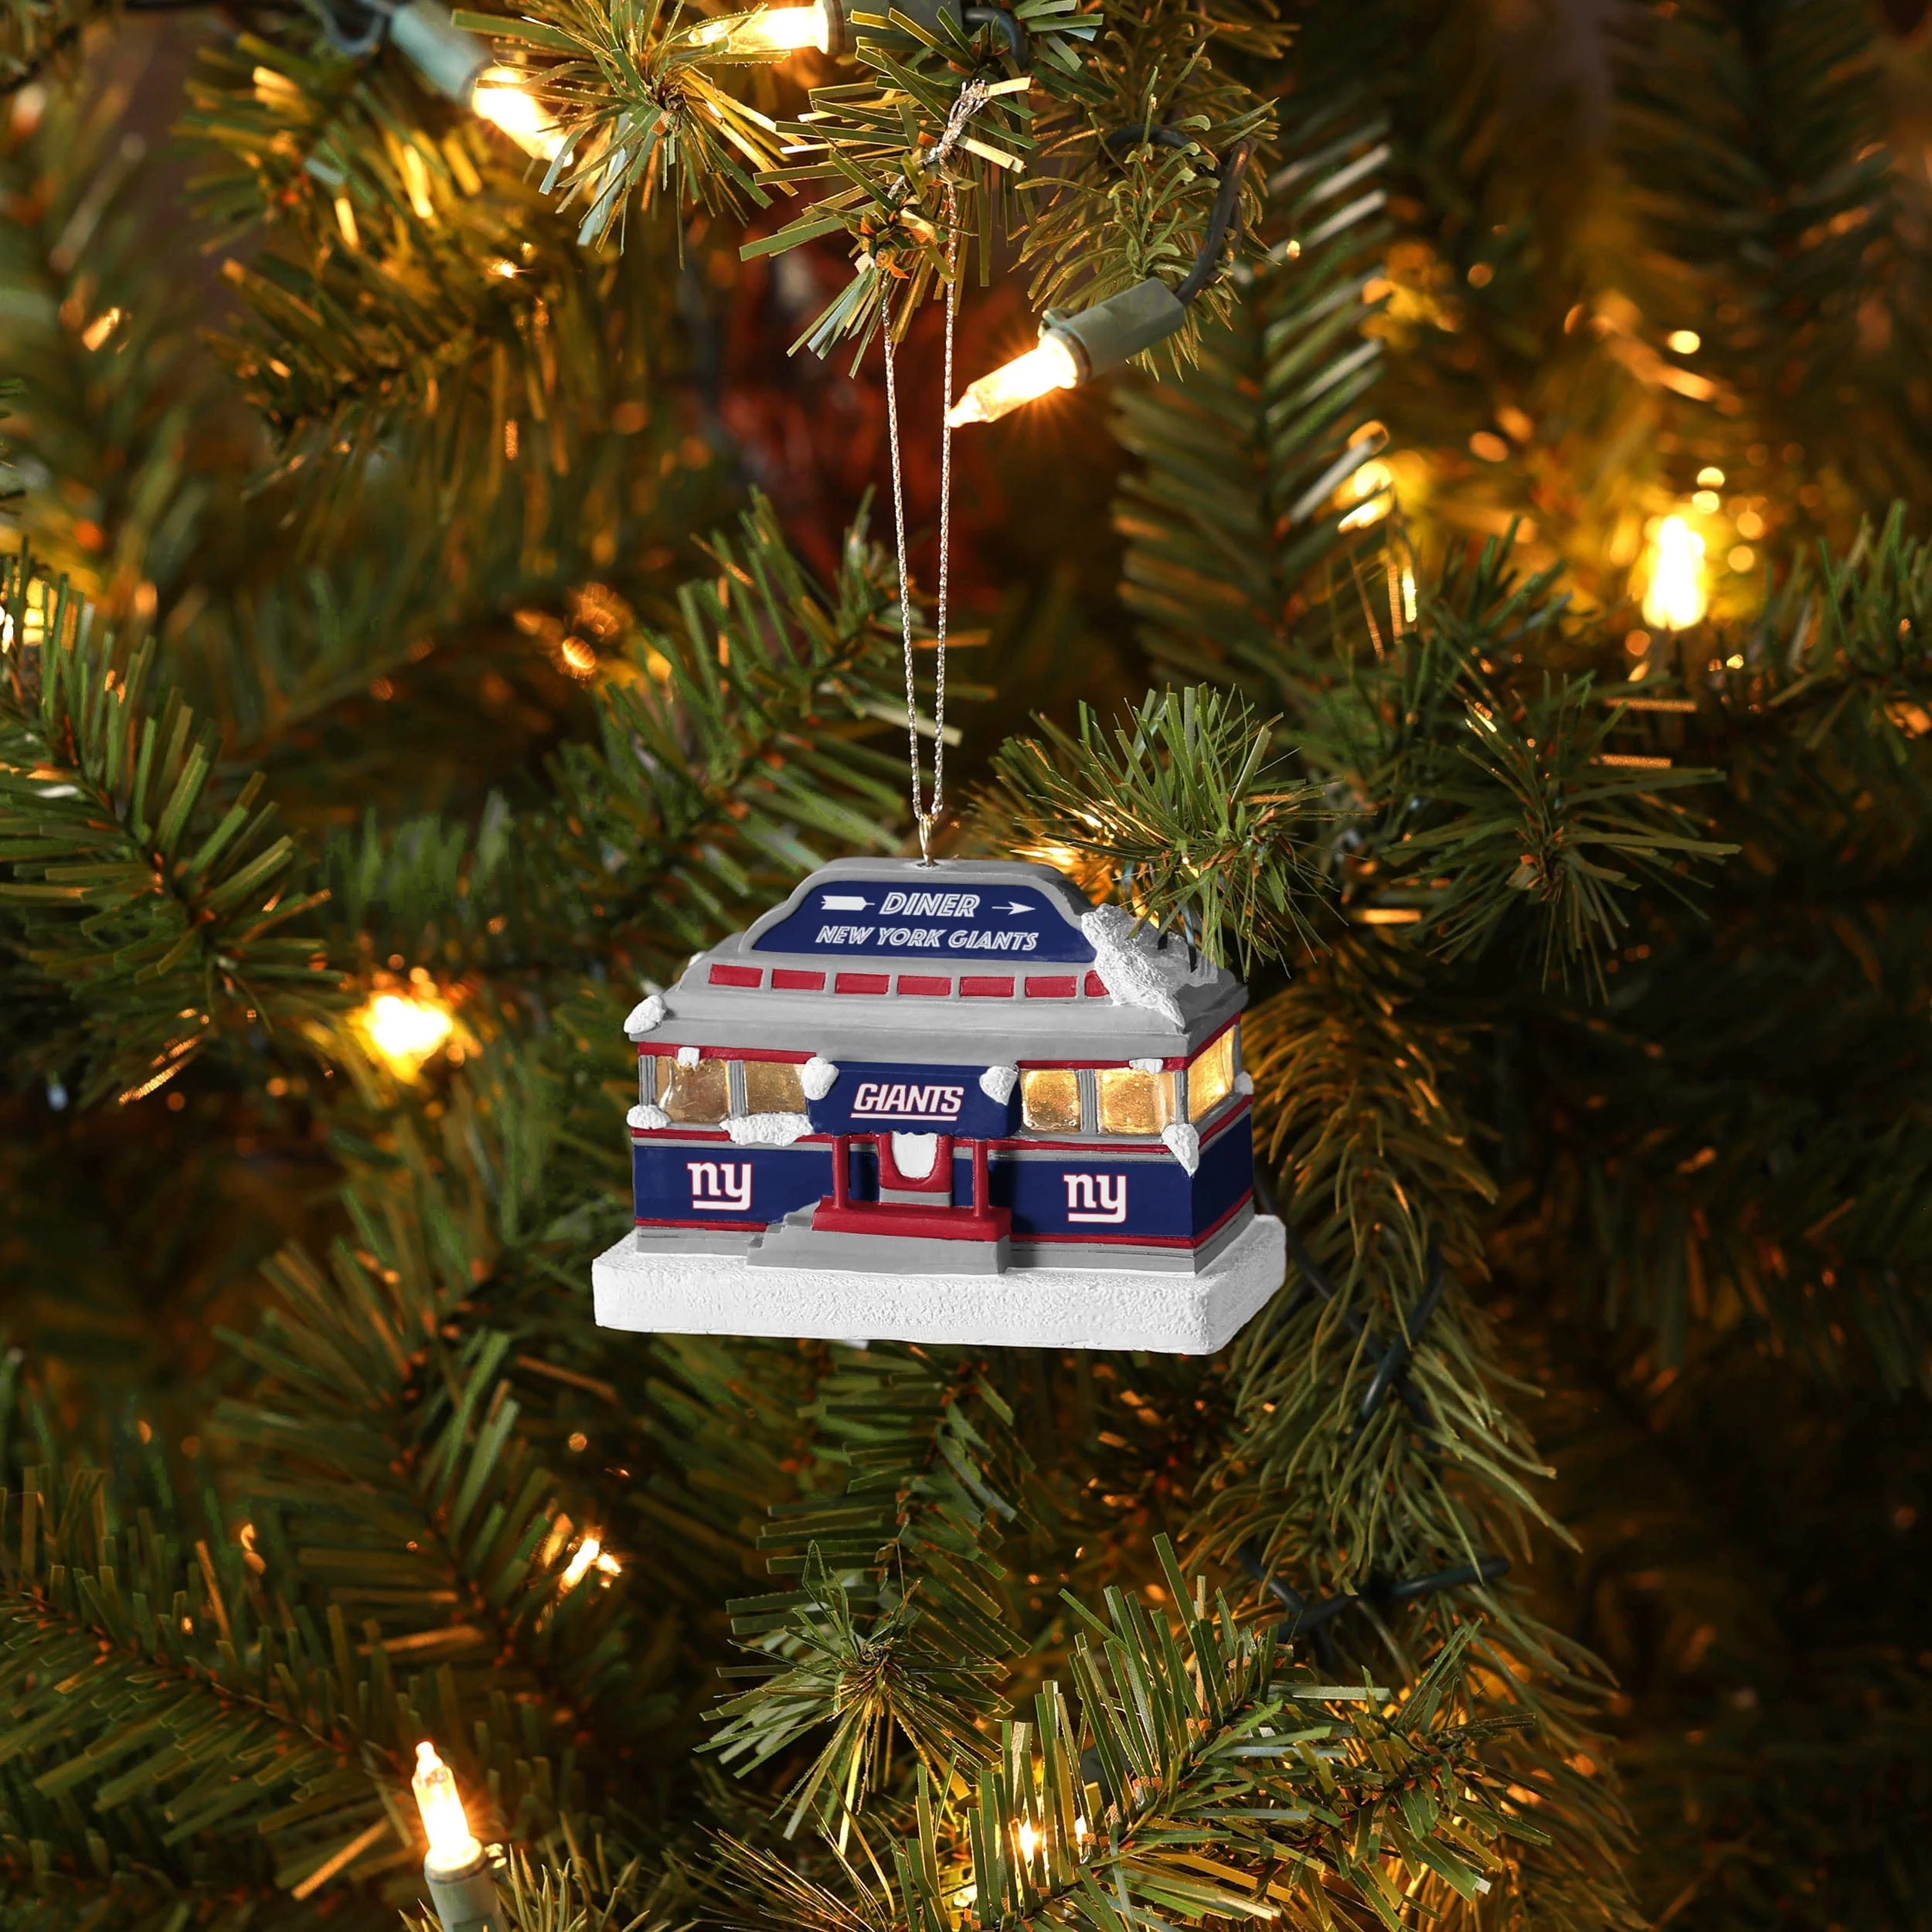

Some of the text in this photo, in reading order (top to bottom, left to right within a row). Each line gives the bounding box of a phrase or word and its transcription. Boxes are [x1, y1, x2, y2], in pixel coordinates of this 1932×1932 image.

[879, 892, 981, 917] DINER
[815, 925, 1039, 951] NEW YORK GIANTS
[851, 1082, 964, 1116] GIANTS
